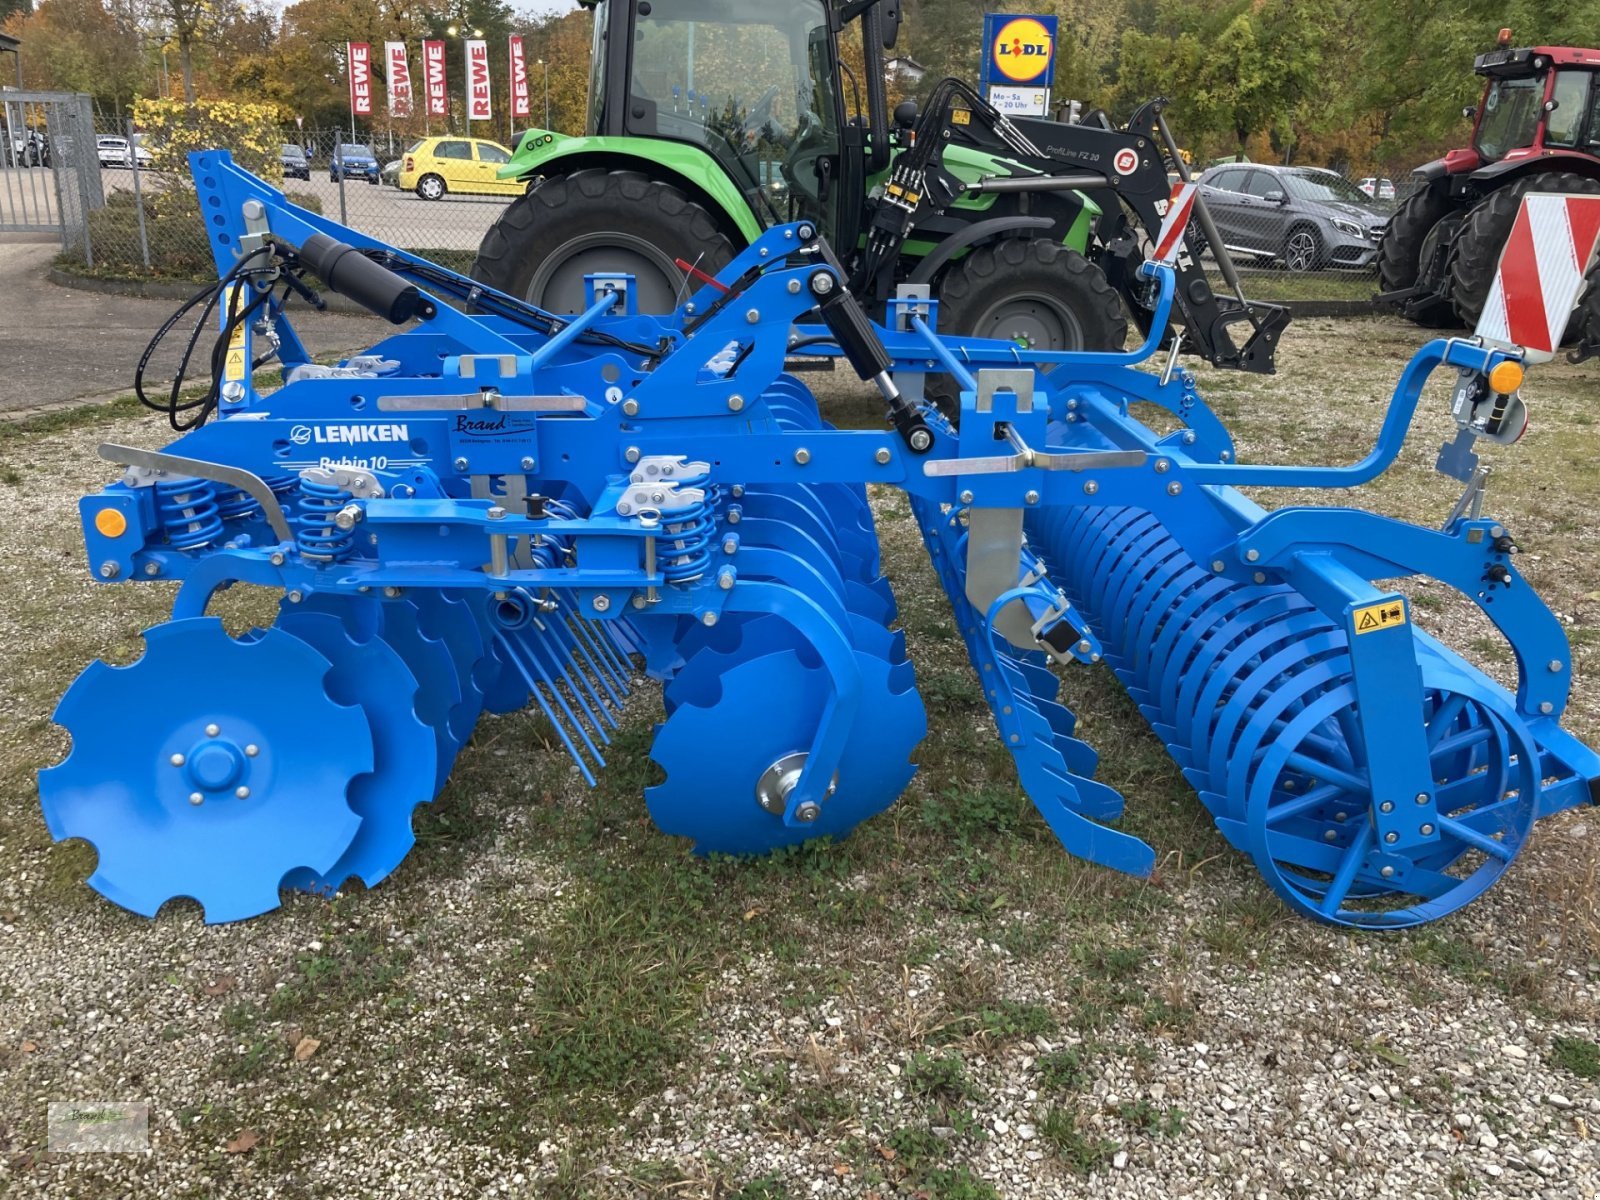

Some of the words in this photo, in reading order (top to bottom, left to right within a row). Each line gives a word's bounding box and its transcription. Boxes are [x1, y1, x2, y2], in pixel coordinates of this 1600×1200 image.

[352, 47, 370, 112] REWE
[391, 49, 409, 113] REWE
[428, 46, 445, 114] REWE
[471, 46, 489, 116] REWE
[513, 41, 529, 114] REWE
[1078, 151, 1090, 160] FZ
[1089, 153, 1100, 161] 20
[314, 424, 409, 447] LEMKEN
[454, 414, 506, 432] Brand
[370, 455, 388, 470] 10
